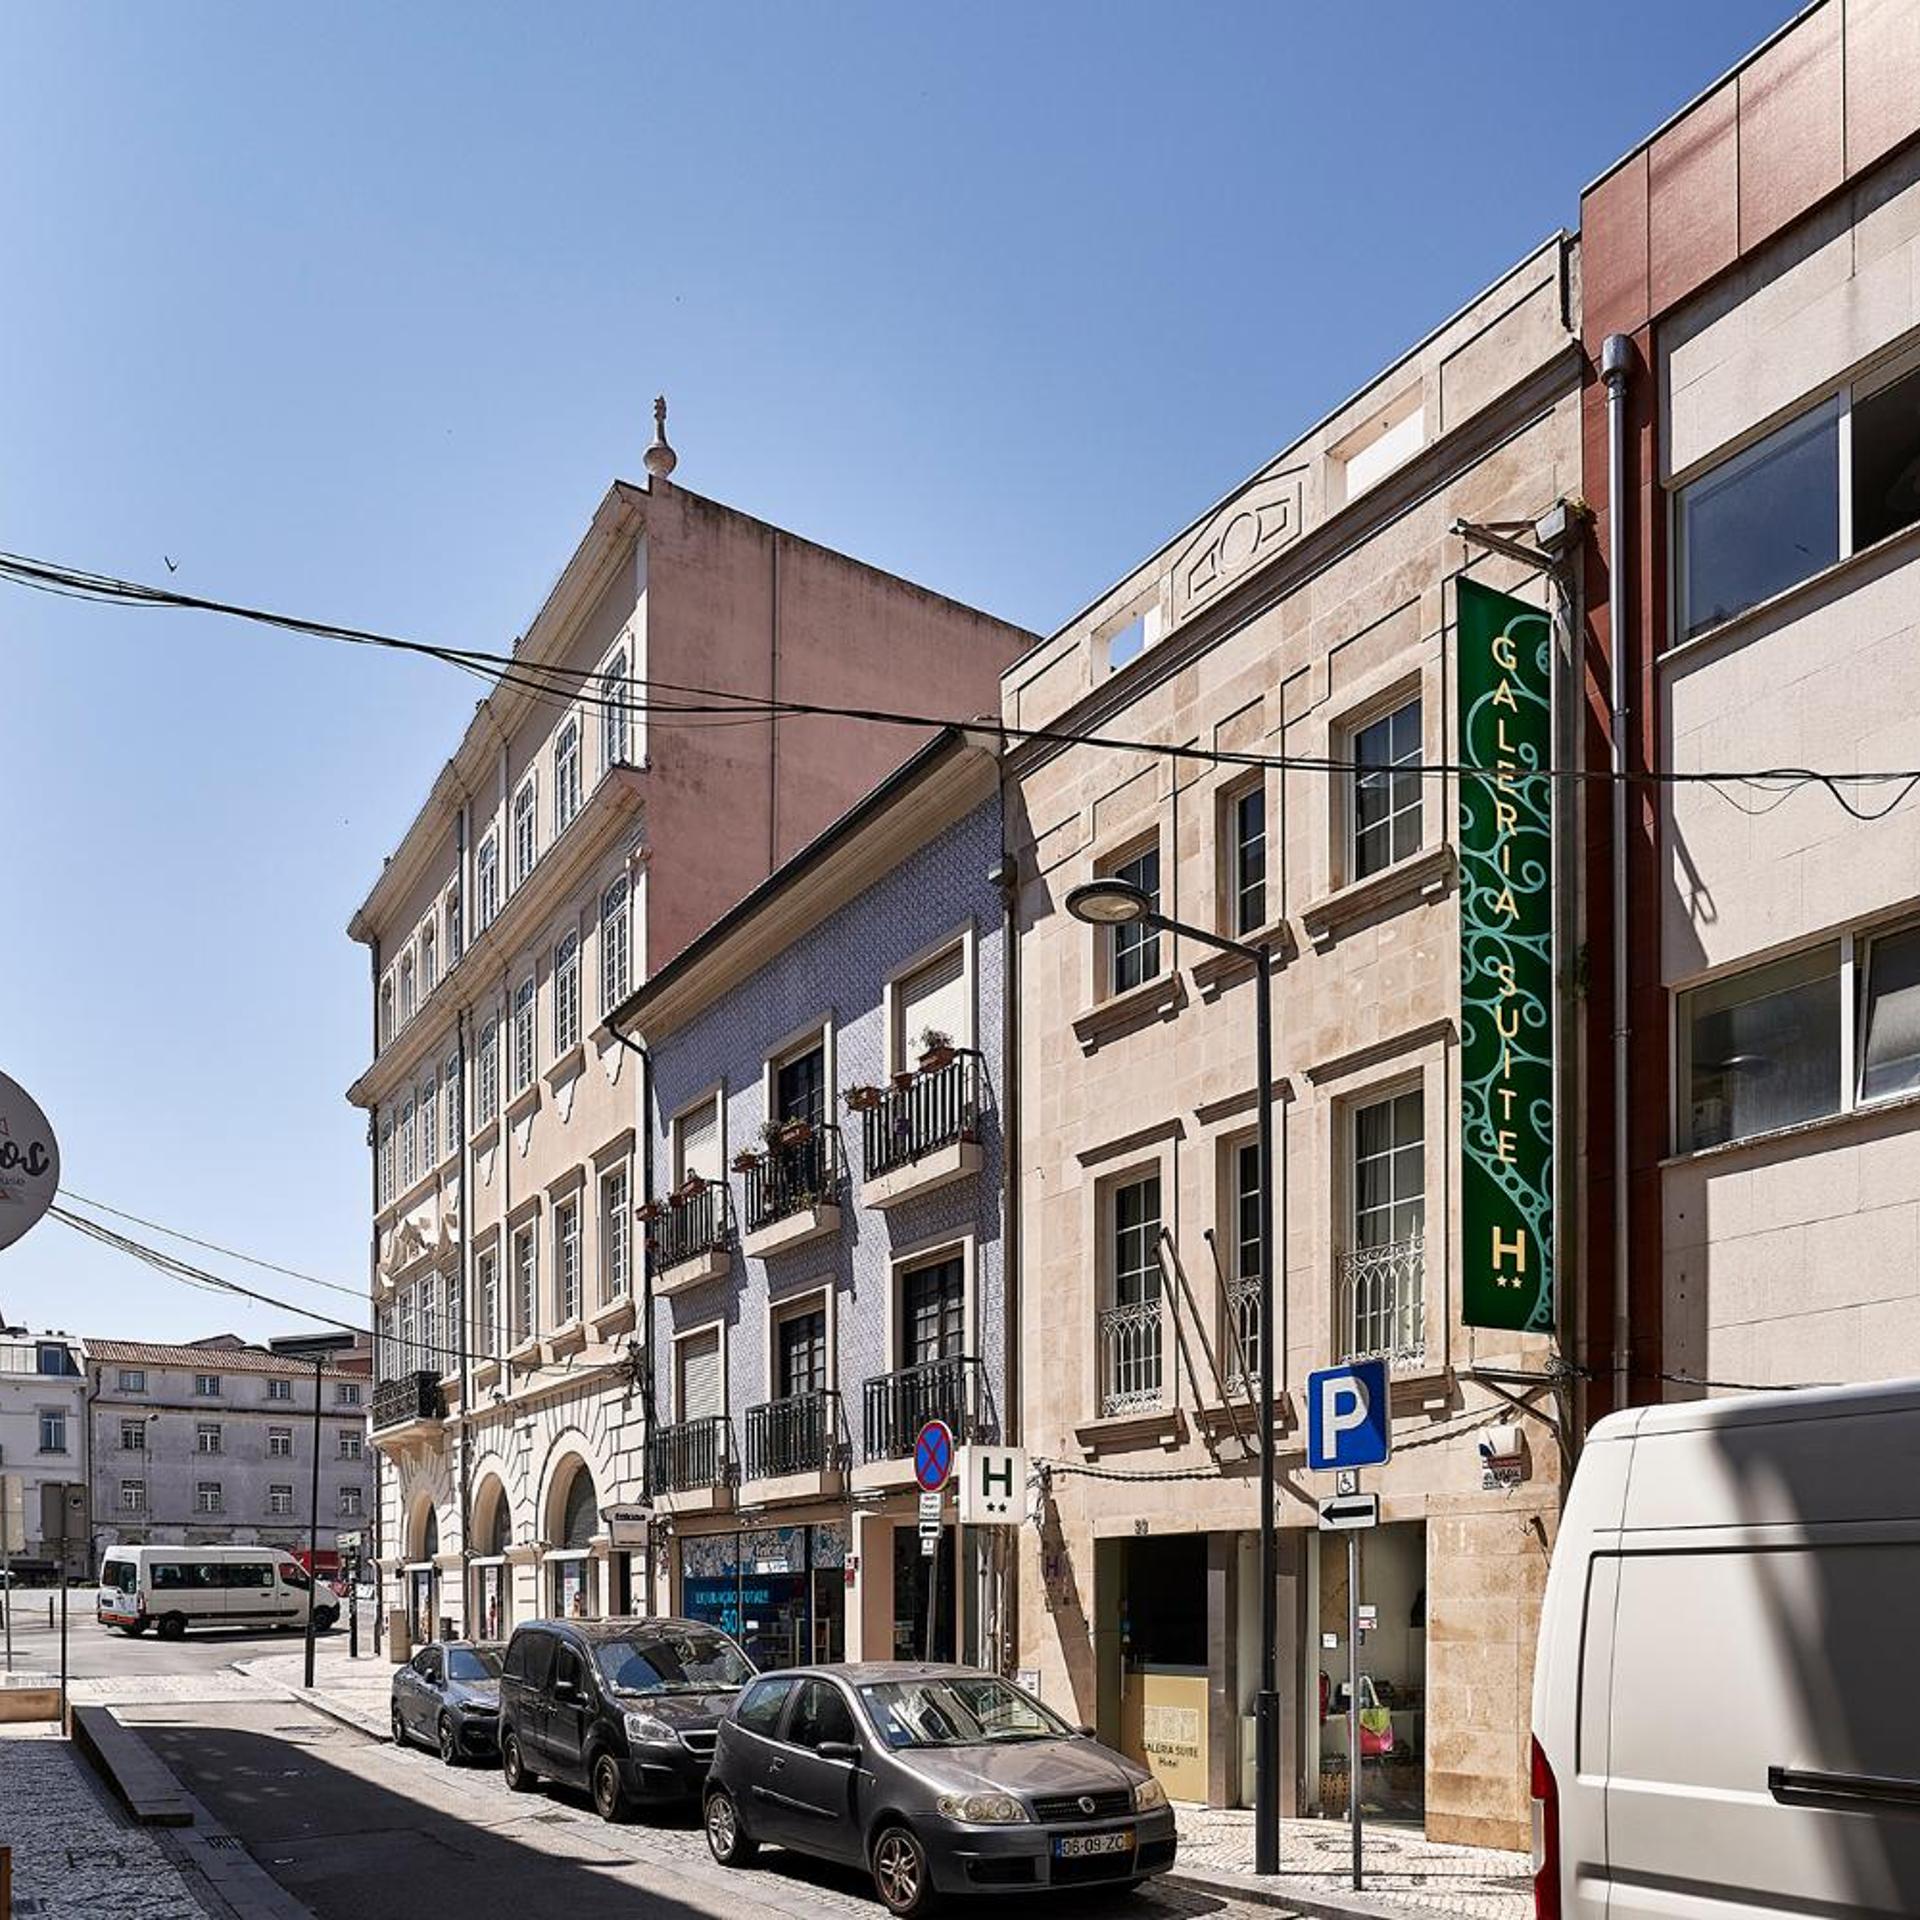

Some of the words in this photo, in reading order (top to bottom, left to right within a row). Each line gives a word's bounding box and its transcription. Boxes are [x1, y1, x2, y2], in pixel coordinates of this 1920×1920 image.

[1491, 635, 1520, 920] GALERIA
[1495, 963, 1519, 1164] SUITE
[1492, 1225, 1526, 1273] H
[1322, 1376, 1370, 1460] P
[983, 1456, 1013, 1498] H
[1063, 1834, 1125, 1856] 06-09-ZC
